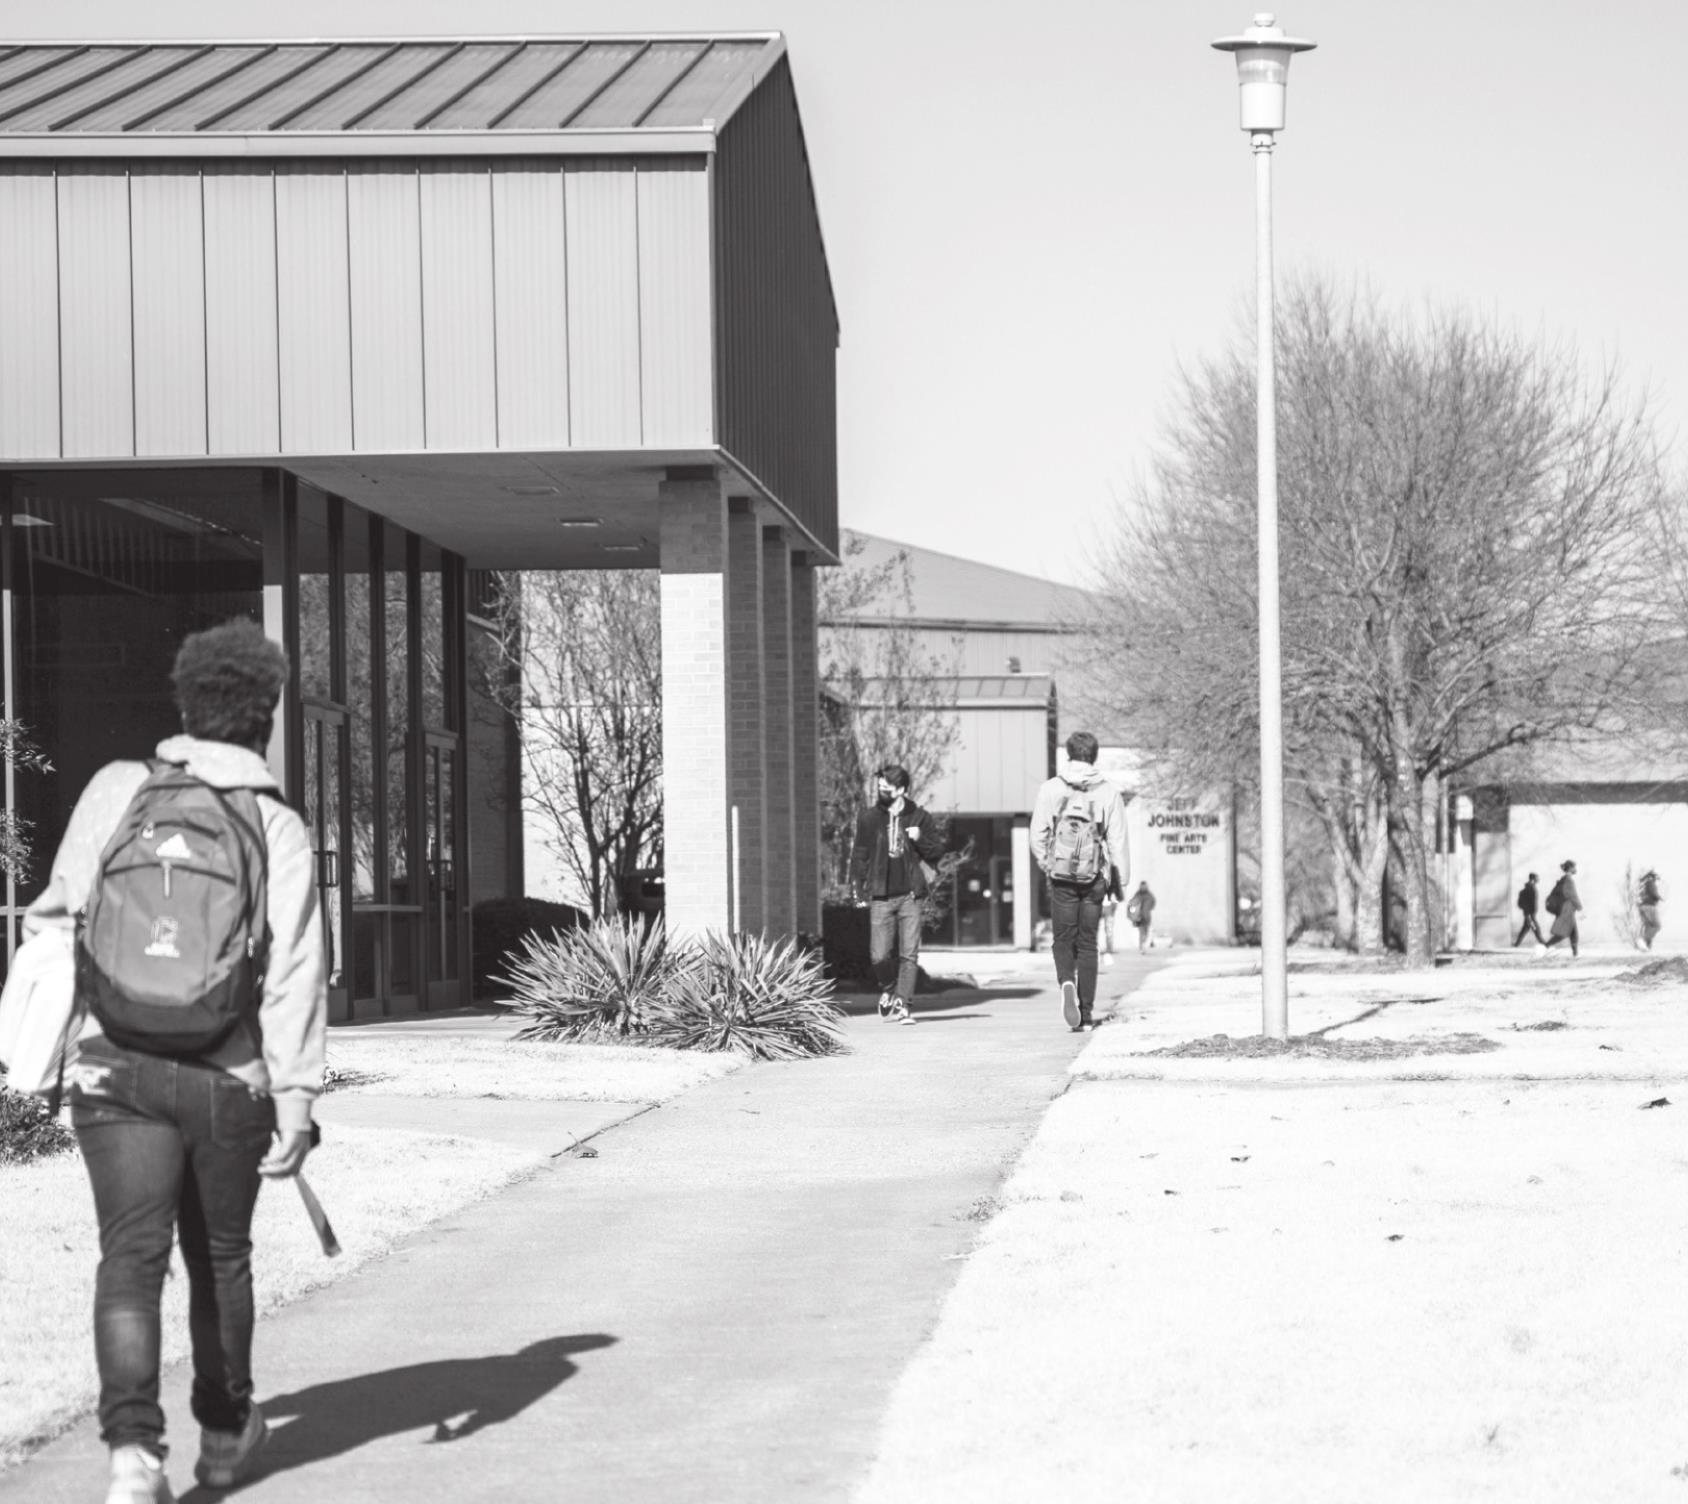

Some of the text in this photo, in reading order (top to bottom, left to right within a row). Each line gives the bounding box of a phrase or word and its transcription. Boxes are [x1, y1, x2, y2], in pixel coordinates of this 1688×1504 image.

[1148, 814, 1219, 828] JOHNSTON
[1184, 833, 1207, 843] ARTS
[1166, 845, 1201, 854] CENTER
